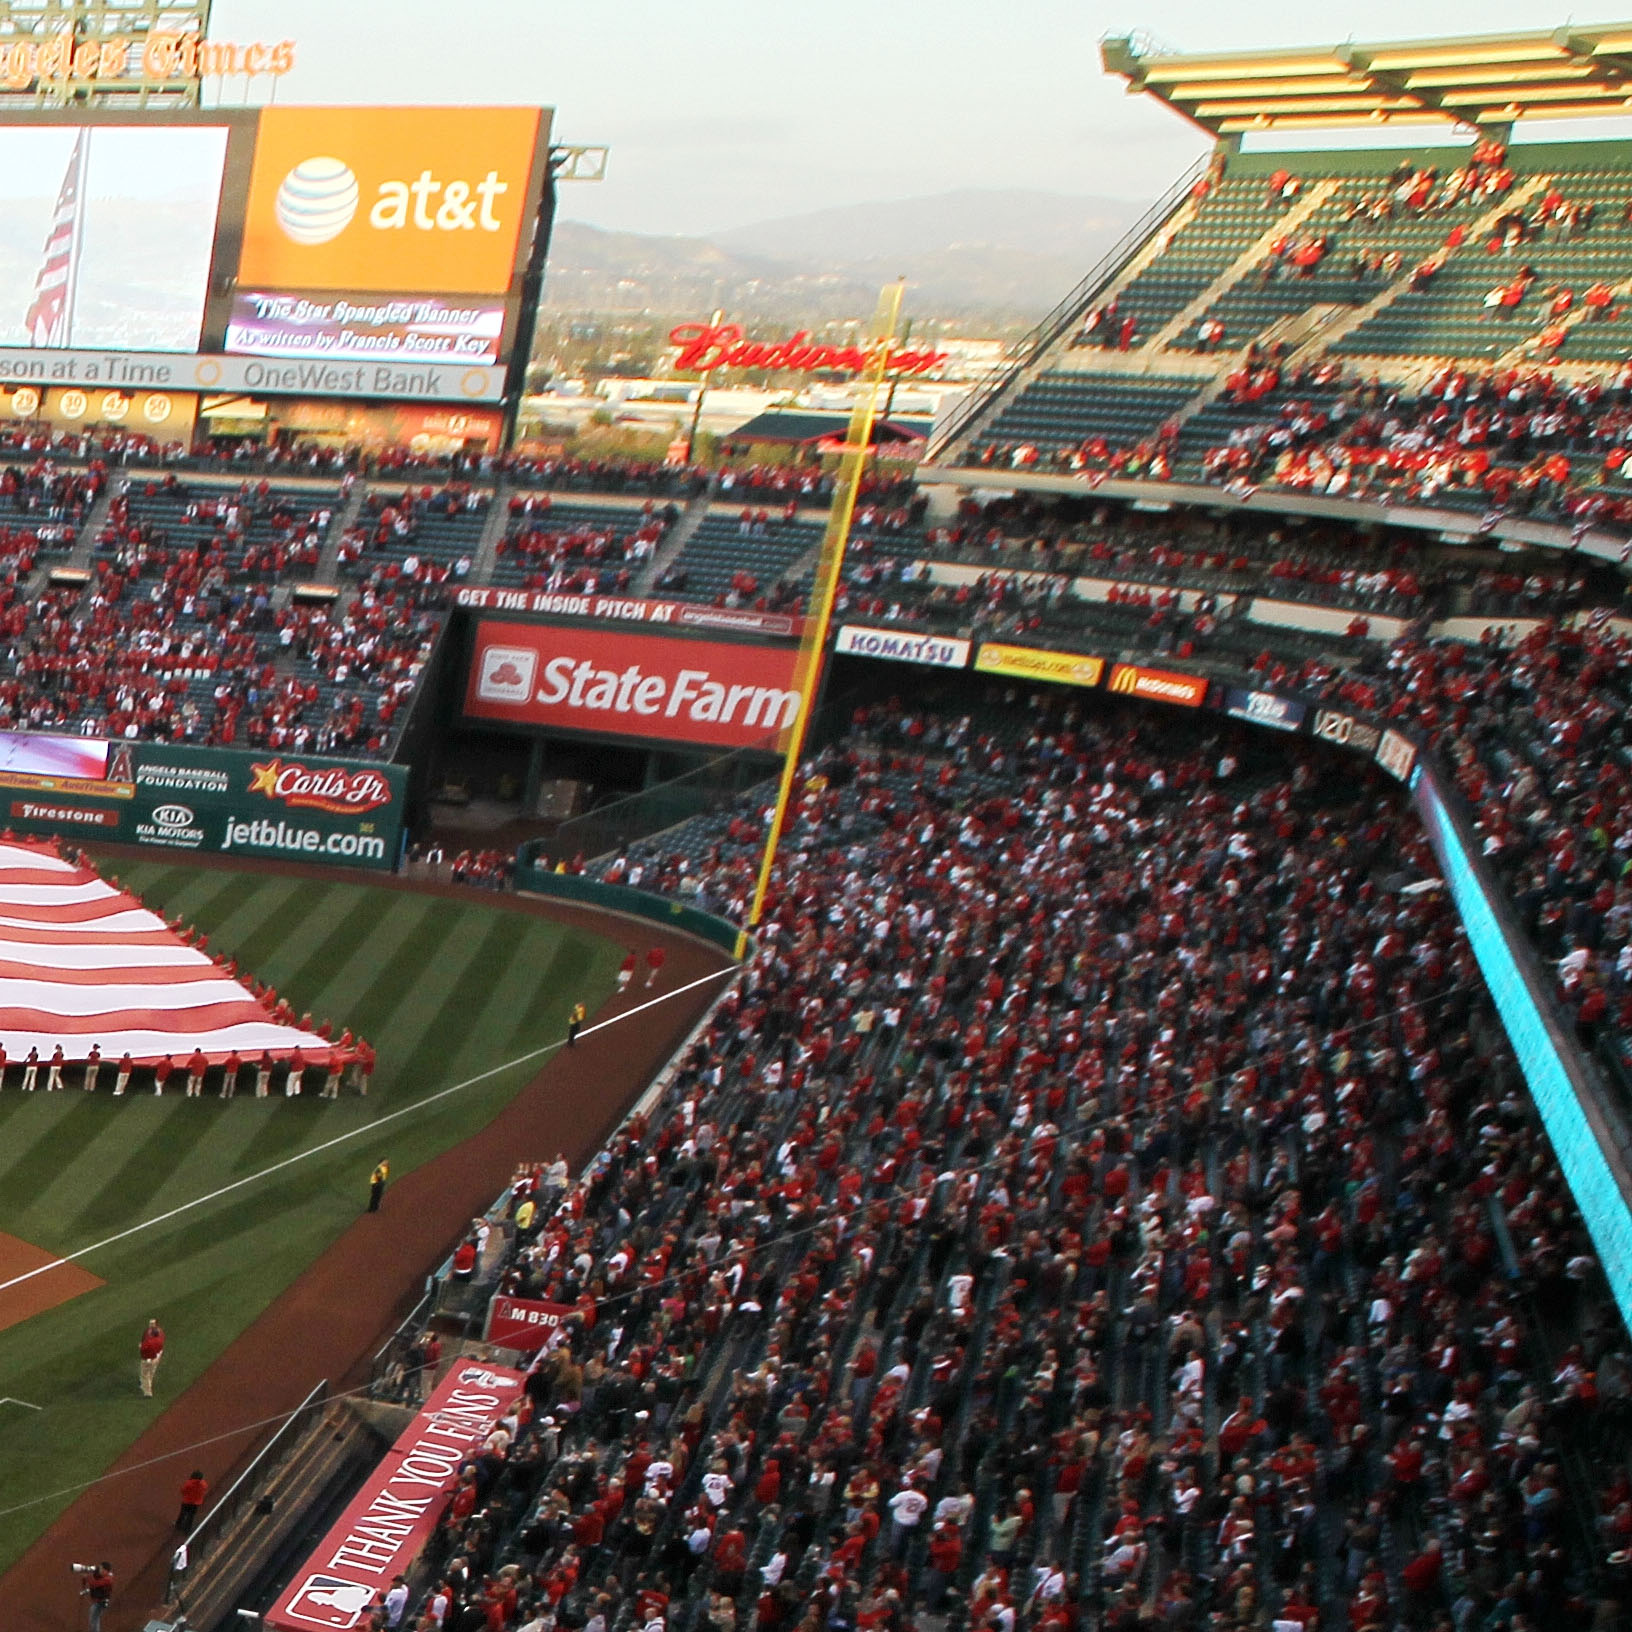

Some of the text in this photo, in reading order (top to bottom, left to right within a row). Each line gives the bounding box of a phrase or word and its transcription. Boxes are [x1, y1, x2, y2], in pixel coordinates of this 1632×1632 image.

[142, 28, 297, 78] Times
[369, 170, 508, 231] at&t
[256, 299, 480, 326] The Star Spangled Banner
[237, 330, 490, 355] As written by Francis Scott Key
[51, 357, 79, 380] at
[85, 362, 100, 380] a
[103, 357, 172, 383] Time
[244, 362, 443, 396] OneWest Bank
[458, 589, 676, 622] GET THE INSIDE PITCH AT
[850, 632, 955, 663] KOMATSU
[537, 656, 804, 730] State Farm
[136, 775, 228, 793] FOUNDATION
[275, 768, 389, 803] Carl's Jr.
[23, 804, 106, 824] Firestone
[159, 809, 187, 824] KIA
[136, 824, 156, 836] KIA
[157, 826, 205, 842] MOTORS
[221, 816, 385, 858] jetblue.com
[528, 1308, 560, 1328] 830
[328, 1487, 433, 1576] THANK
[392, 1438, 464, 1489] YOU
